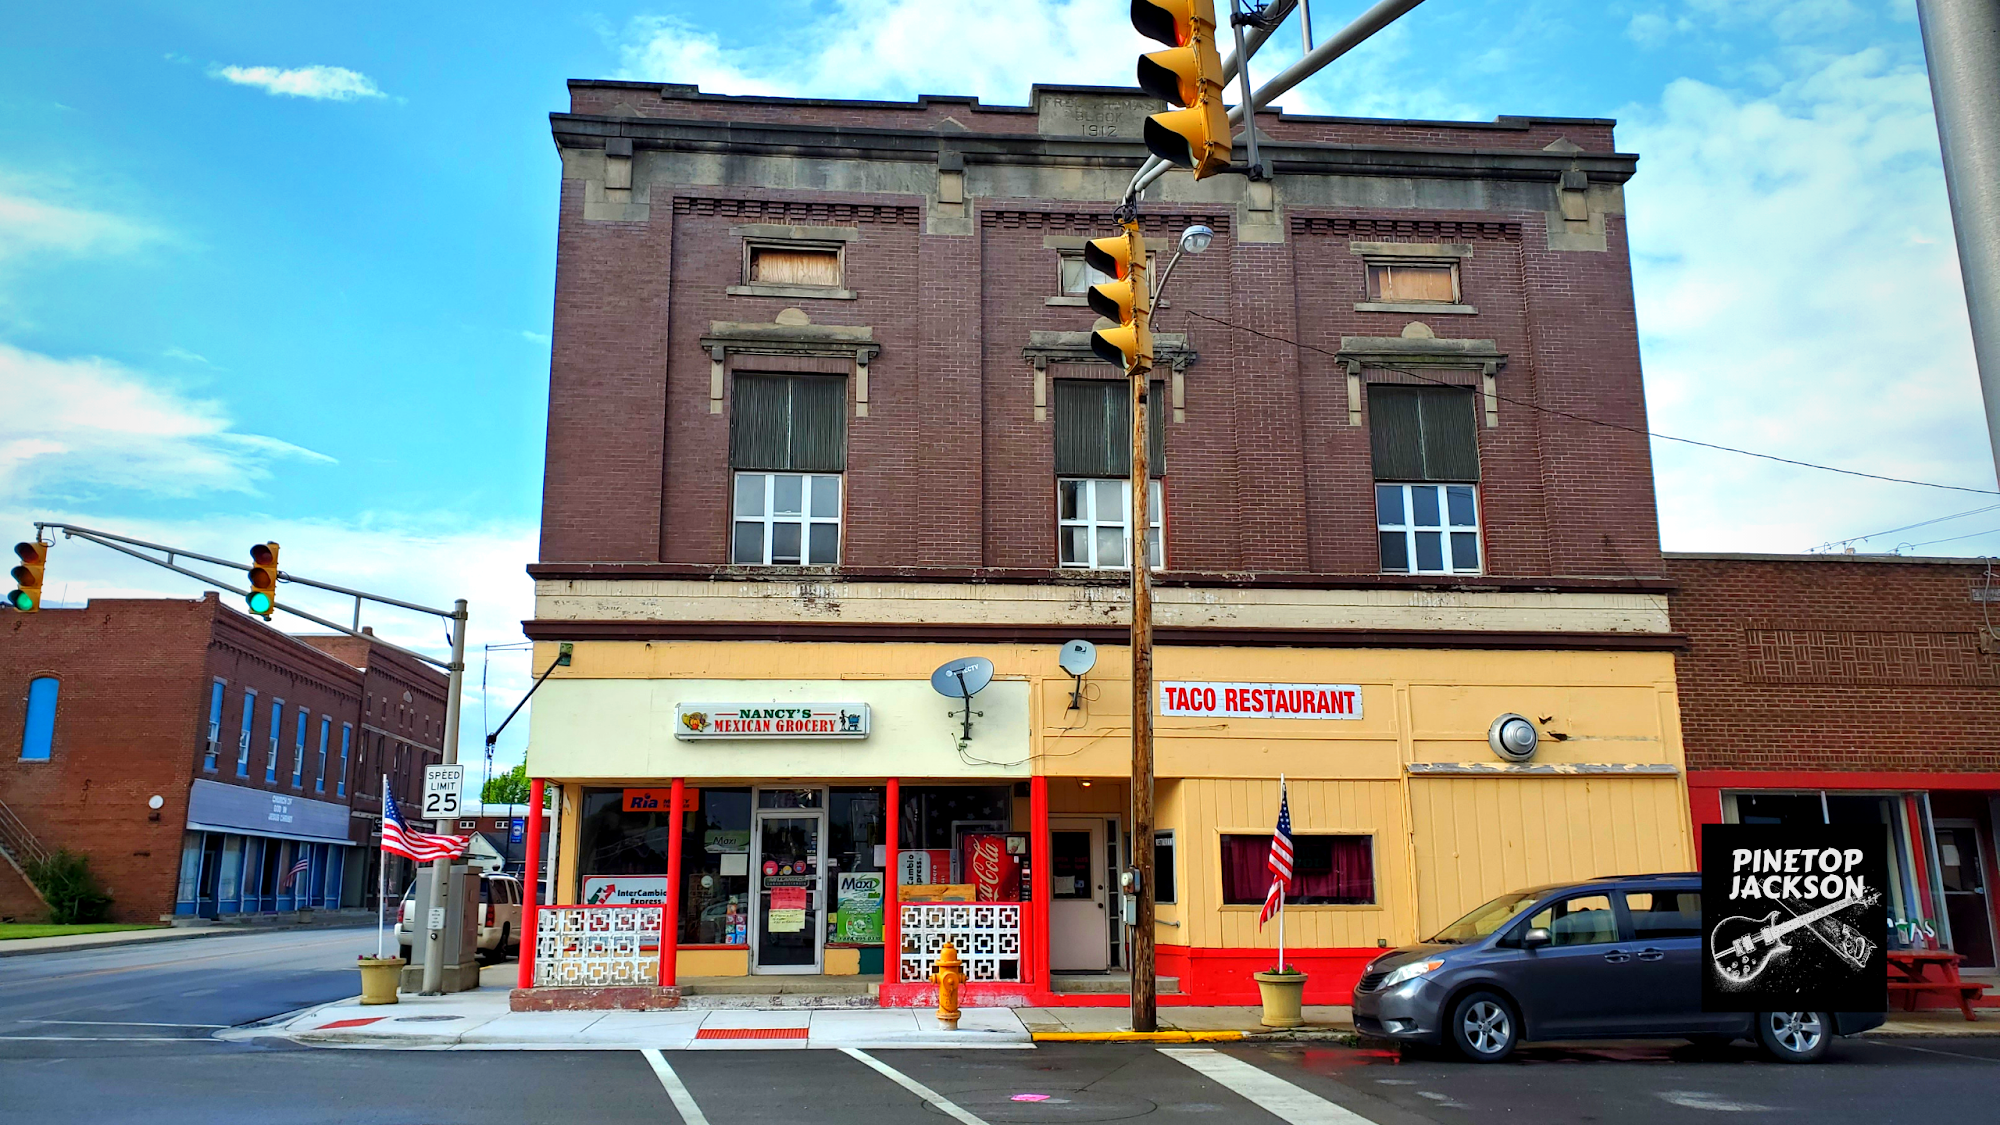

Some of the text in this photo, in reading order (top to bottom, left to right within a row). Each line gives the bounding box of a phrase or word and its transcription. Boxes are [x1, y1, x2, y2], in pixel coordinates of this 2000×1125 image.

[1082, 124, 1118, 137] 1912
[1165, 687, 1355, 714] TACO RESTAURANT
[739, 709, 812, 719] NANCY'S
[714, 719, 837, 732] MEXICAN GROCERY
[428, 771, 460, 780] SPEED
[431, 782, 456, 791] LIMIT
[426, 793, 457, 812] 25
[630, 793, 658, 809] Ria
[713, 836, 737, 845] Maxi
[841, 877, 873, 890] Maxi
